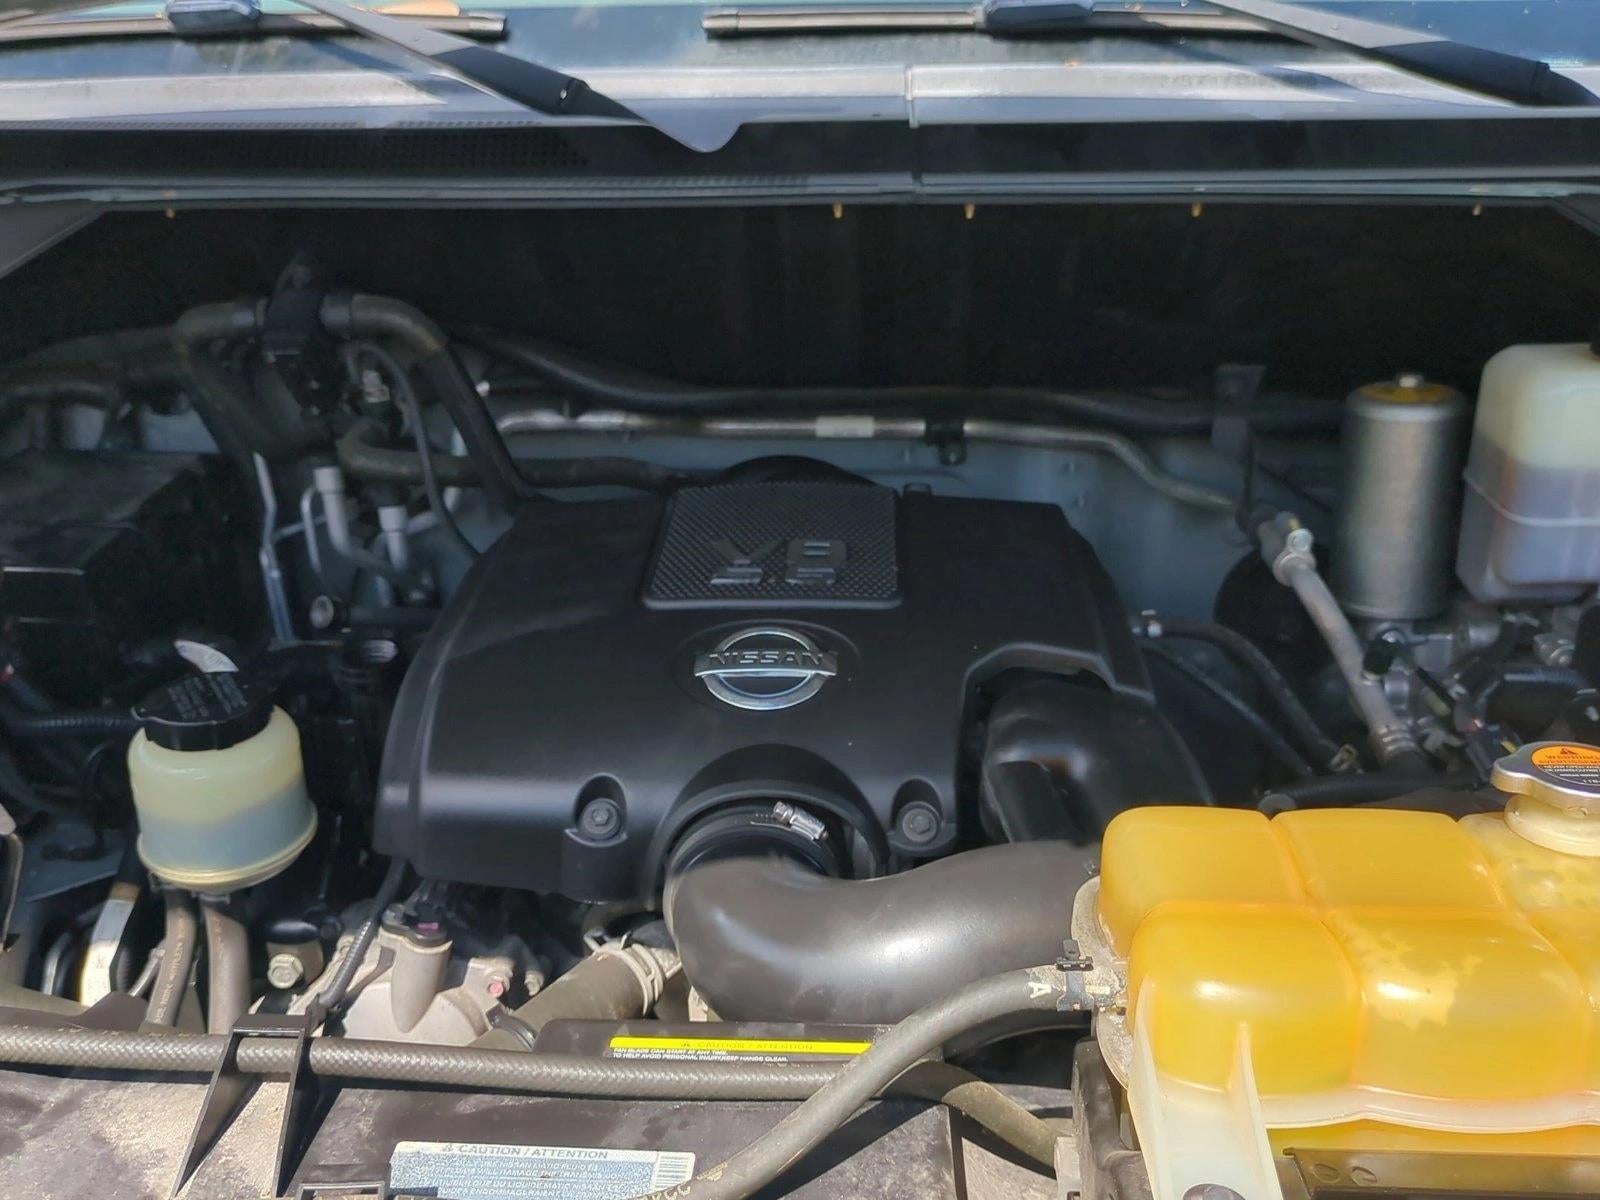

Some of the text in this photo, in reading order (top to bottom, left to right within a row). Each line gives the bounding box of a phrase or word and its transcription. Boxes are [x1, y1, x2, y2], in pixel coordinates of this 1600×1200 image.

[707, 650, 825, 666] NISSAN
[1028, 981, 1052, 998] A
[697, 1041, 745, 1049] CAUTION
[756, 1042, 813, 1050] ATTENTION
[458, 1144, 520, 1156] CAUTION
[532, 1148, 609, 1159] ATTENTION
